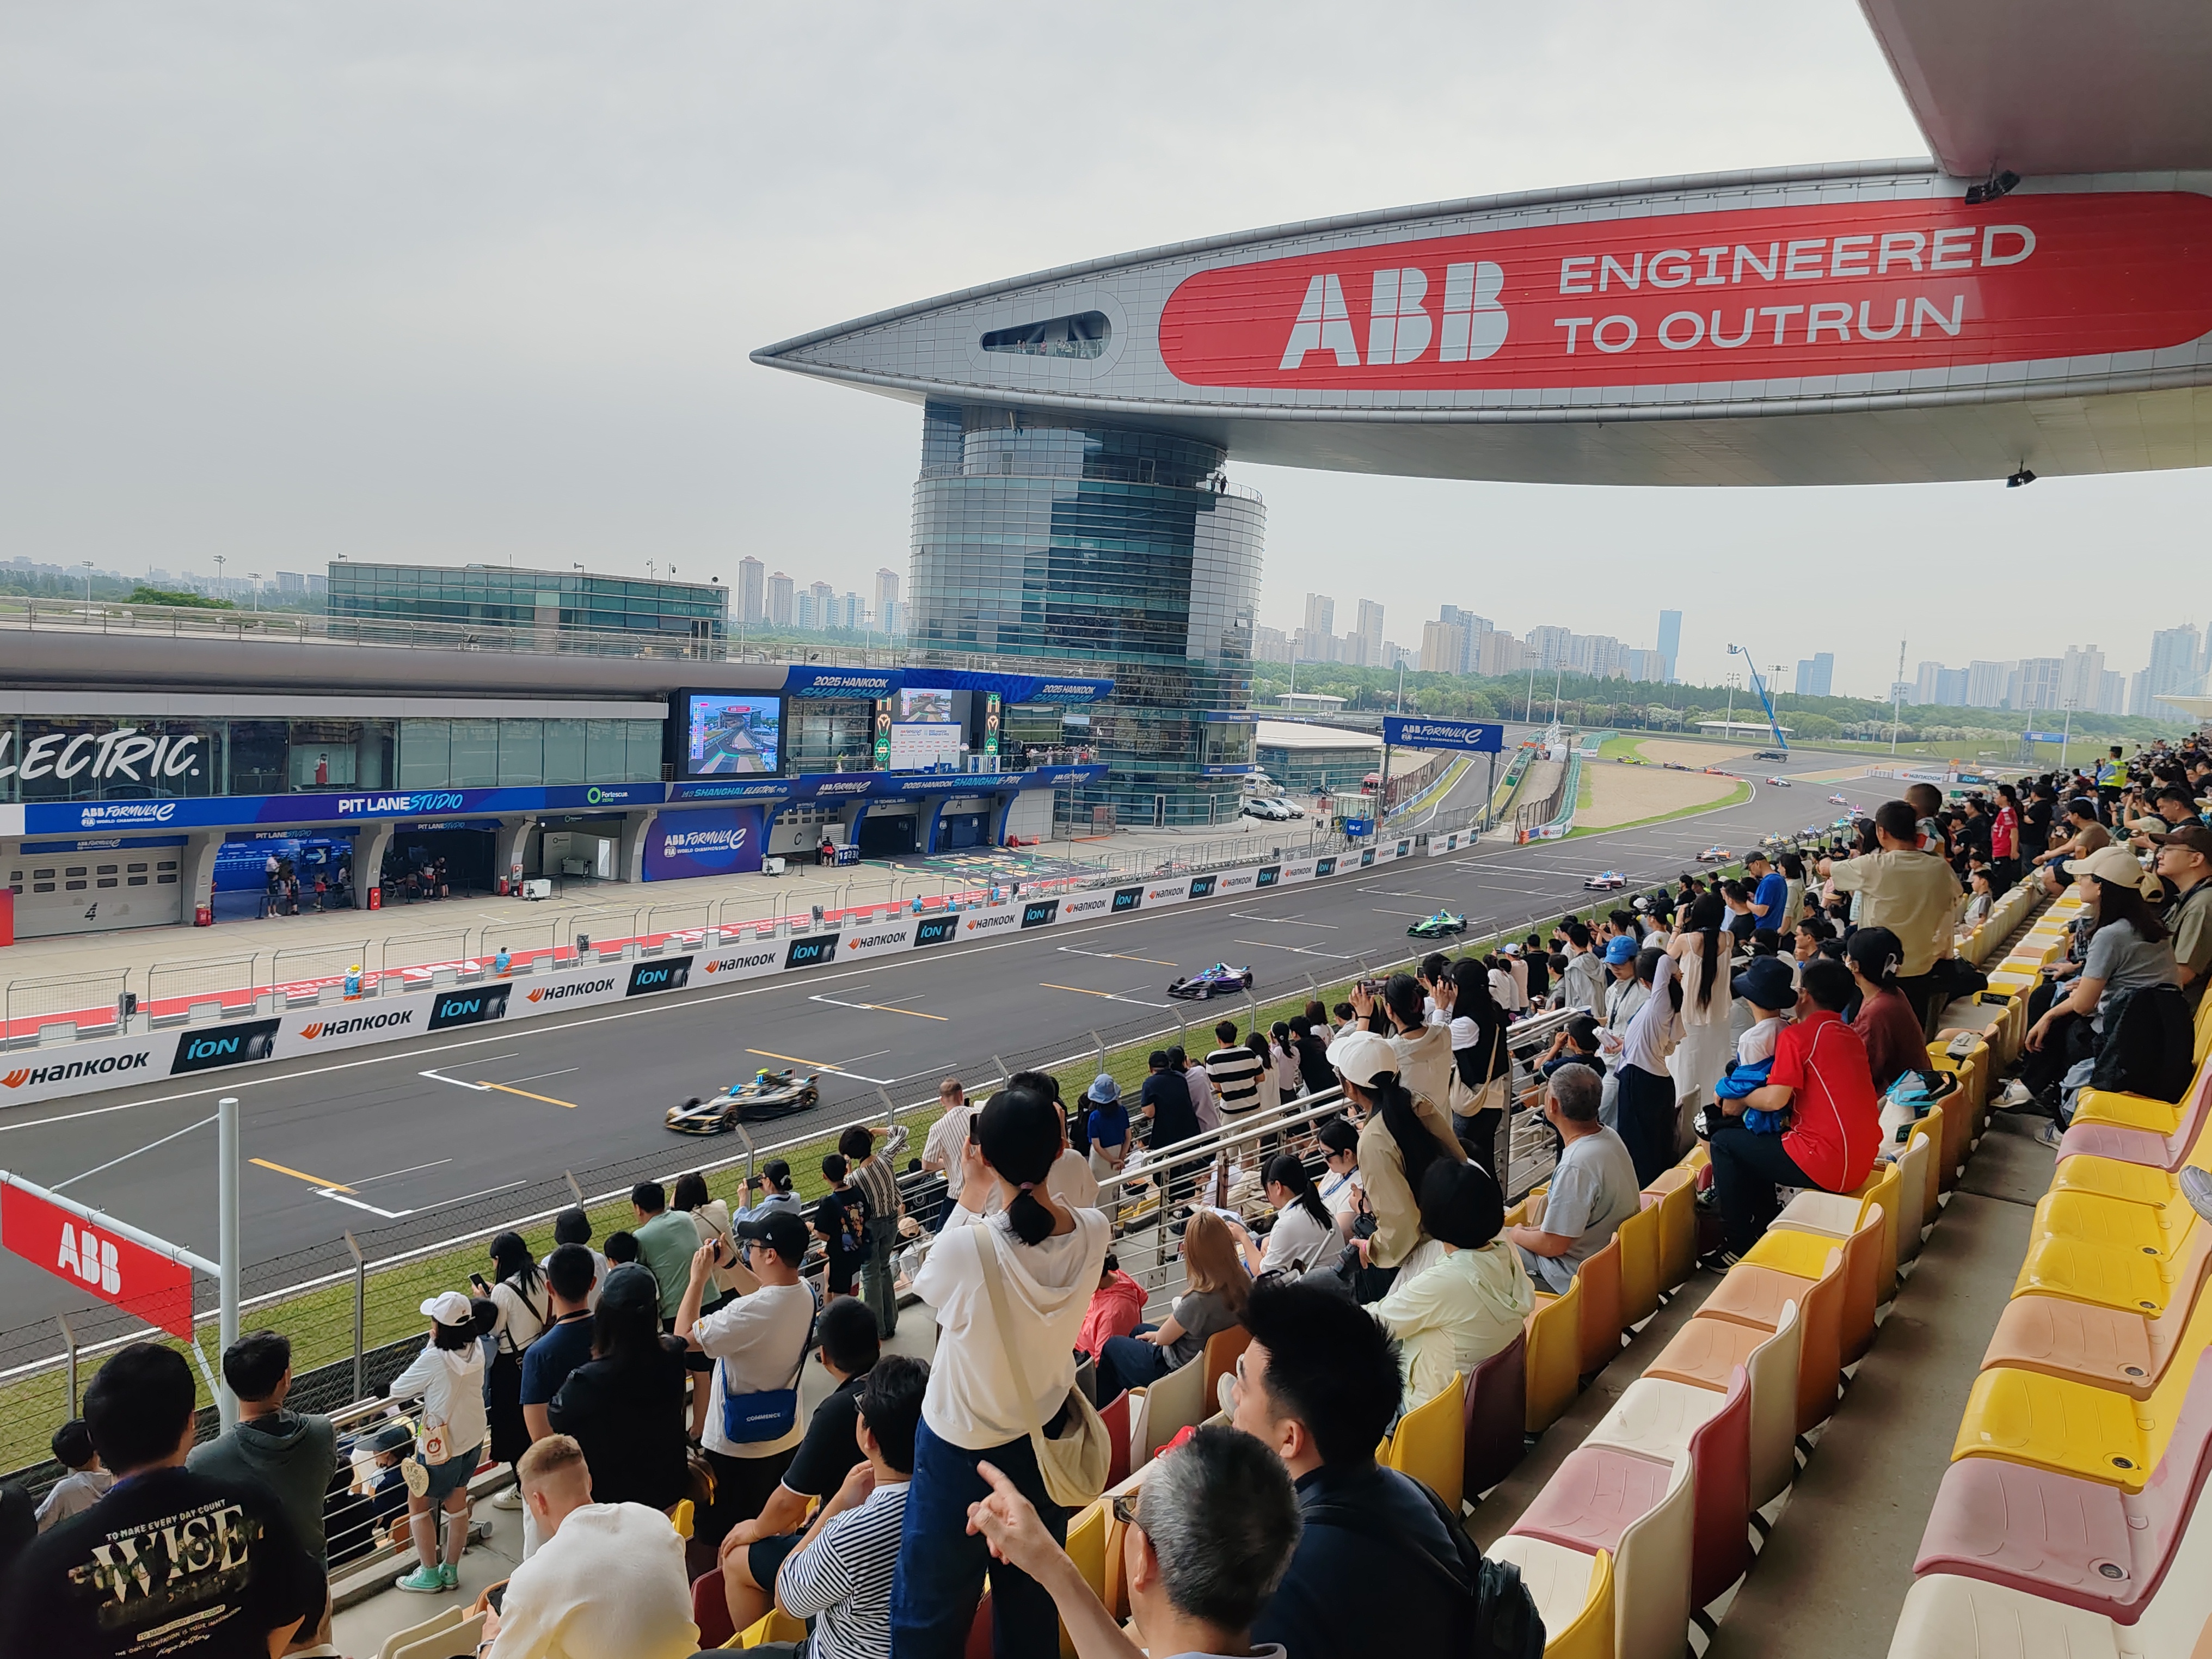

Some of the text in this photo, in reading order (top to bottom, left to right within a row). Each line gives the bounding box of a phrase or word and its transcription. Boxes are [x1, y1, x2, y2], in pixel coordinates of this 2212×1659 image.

[1558, 224, 2036, 294] ENGINEERED
[1278, 261, 1509, 370] ABB
[1554, 295, 1965, 354] TO OUTRUN
[813, 676, 889, 688] 2025 HANKOOK
[1042, 685, 1096, 695] 2025 HANKOOK
[1402, 724, 1421, 733] ABB
[1420, 726, 1466, 736] FORMULA
[339, 794, 464, 813] PIT LANE STUDIO
[955, 800, 962, 809] A
[82, 808, 105, 817] ABB
[105, 805, 157, 818] FORMULA
[665, 834, 685, 846] ABB
[685, 831, 732, 845] FORMULA
[794, 832, 802, 845] C
[664, 846, 677, 858] FIA
[84, 902, 98, 920] 4
[57, 1221, 121, 1295] ABB
[746, 1412, 782, 1422] COMMENCE
[106, 1499, 226, 1541] TO MAKE EVERY DAY COUNT
[91, 1504, 248, 1605] WISE
[189, 1623, 207, 1633] YOUR
